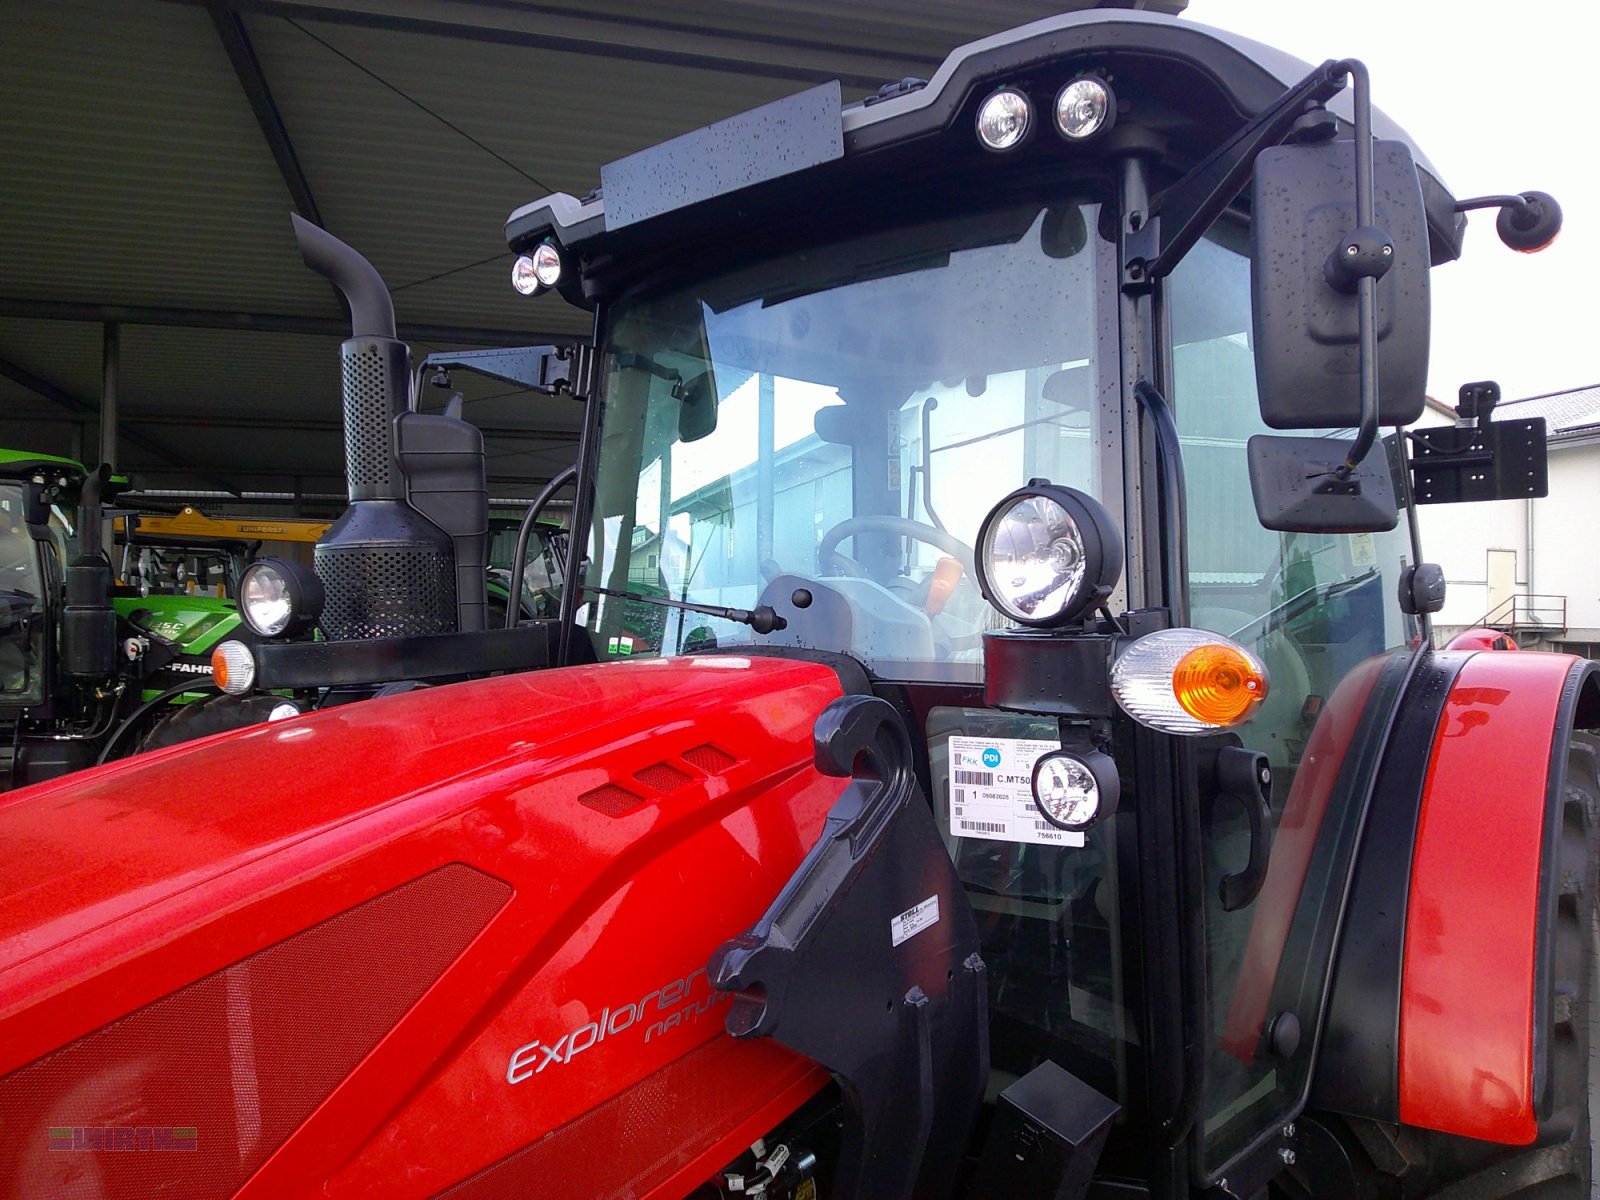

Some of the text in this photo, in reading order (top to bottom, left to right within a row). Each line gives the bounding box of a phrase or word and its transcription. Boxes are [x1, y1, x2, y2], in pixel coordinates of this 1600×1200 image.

[983, 753, 998, 763] PDI
[973, 790, 977, 800] 1
[1037, 831, 1062, 841] 756610
[900, 905, 919, 922] STOLL
[505, 967, 706, 1085] Explorer
